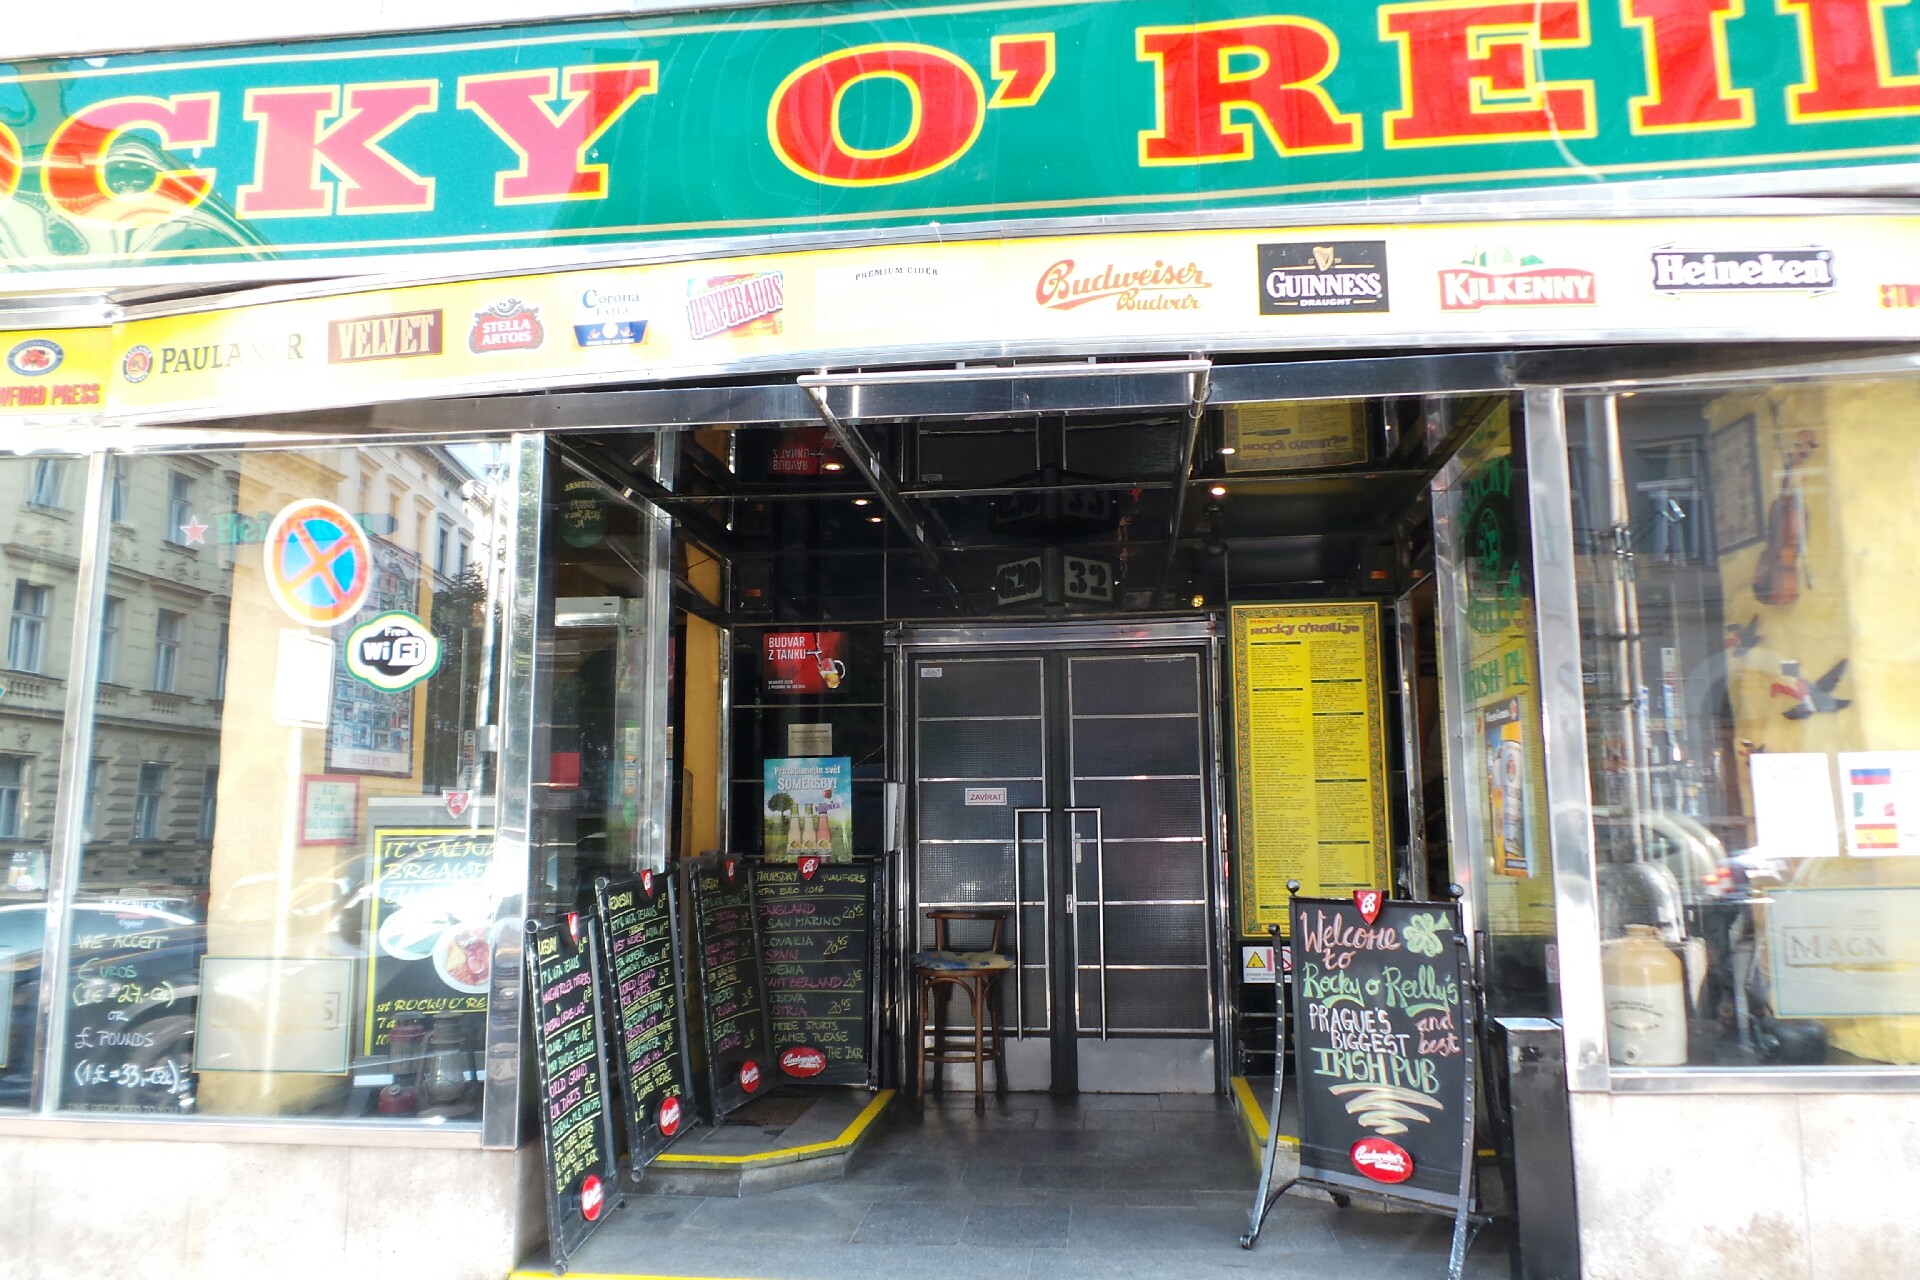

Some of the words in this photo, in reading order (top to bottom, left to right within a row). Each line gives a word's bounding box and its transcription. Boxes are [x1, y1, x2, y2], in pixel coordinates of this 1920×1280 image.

[0, 60, 658, 229] CKY
[855, 267, 903, 280] PREMIUM
[907, 267, 938, 276] CIDER
[1655, 253, 1831, 286] Heineken
[1035, 259, 1212, 308] Budweiser
[1266, 271, 1383, 299] GUINNESS
[1444, 272, 1594, 304] KILKENNY
[583, 290, 640, 310] Corona
[689, 275, 784, 336] DESPERADOS
[1116, 287, 1201, 310] Budvar
[1300, 298, 1352, 308] DRAUGHT
[482, 319, 531, 334] STELLA
[337, 314, 434, 361] VELVET
[481, 330, 532, 346] ARTOIS
[160, 332, 305, 374] PAULANR
[50, 383, 100, 406] PRESS
[564, 481, 602, 492] JAMESON
[1001, 559, 1041, 599] 620
[1069, 559, 1107, 597] 32
[384, 627, 408, 638] Free
[768, 637, 805, 648] BUDVAR
[768, 649, 775, 660] Z
[776, 649, 806, 660] TANKU
[778, 777, 837, 790] SOMERSBY!
[970, 792, 1002, 801] ZAVÍRAT
[384, 841, 428, 858] IT'S
[756, 871, 798, 882] THURSDAY
[758, 888, 775, 896] EFA
[759, 904, 816, 916] ENGLAND
[768, 918, 791, 929] SAN
[795, 917, 841, 928] MARINO
[1300, 909, 1401, 953] Welcome
[78, 934, 106, 949] WE
[113, 935, 168, 949] ACCEPT
[538, 935, 556, 957] UESDAY
[763, 937, 814, 947] LOVAKIA
[765, 950, 798, 960] SPAIN
[1322, 948, 1356, 971] to
[768, 977, 842, 988] WITZERLAND
[1302, 962, 1365, 1006] Rocky
[395, 998, 446, 1011] ROCKY
[108, 1011, 128, 1021] OR
[1309, 1003, 1392, 1034] PRAGUE'S
[1415, 1010, 1455, 1032] and
[773, 1021, 798, 1031] MORE
[805, 1021, 838, 1031] SPORTS
[96, 1031, 154, 1047] POUNDS
[775, 1033, 807, 1043] GAMES
[812, 1032, 848, 1043] PLEASE
[1331, 1030, 1410, 1057] BIGGEST
[1417, 1031, 1461, 1057] best
[825, 1047, 843, 1060] THE
[845, 1048, 863, 1060] BAR
[1310, 1047, 1388, 1085] IRISH
[1390, 1054, 1440, 1093] PUB
[549, 1077, 565, 1098] ORLD
